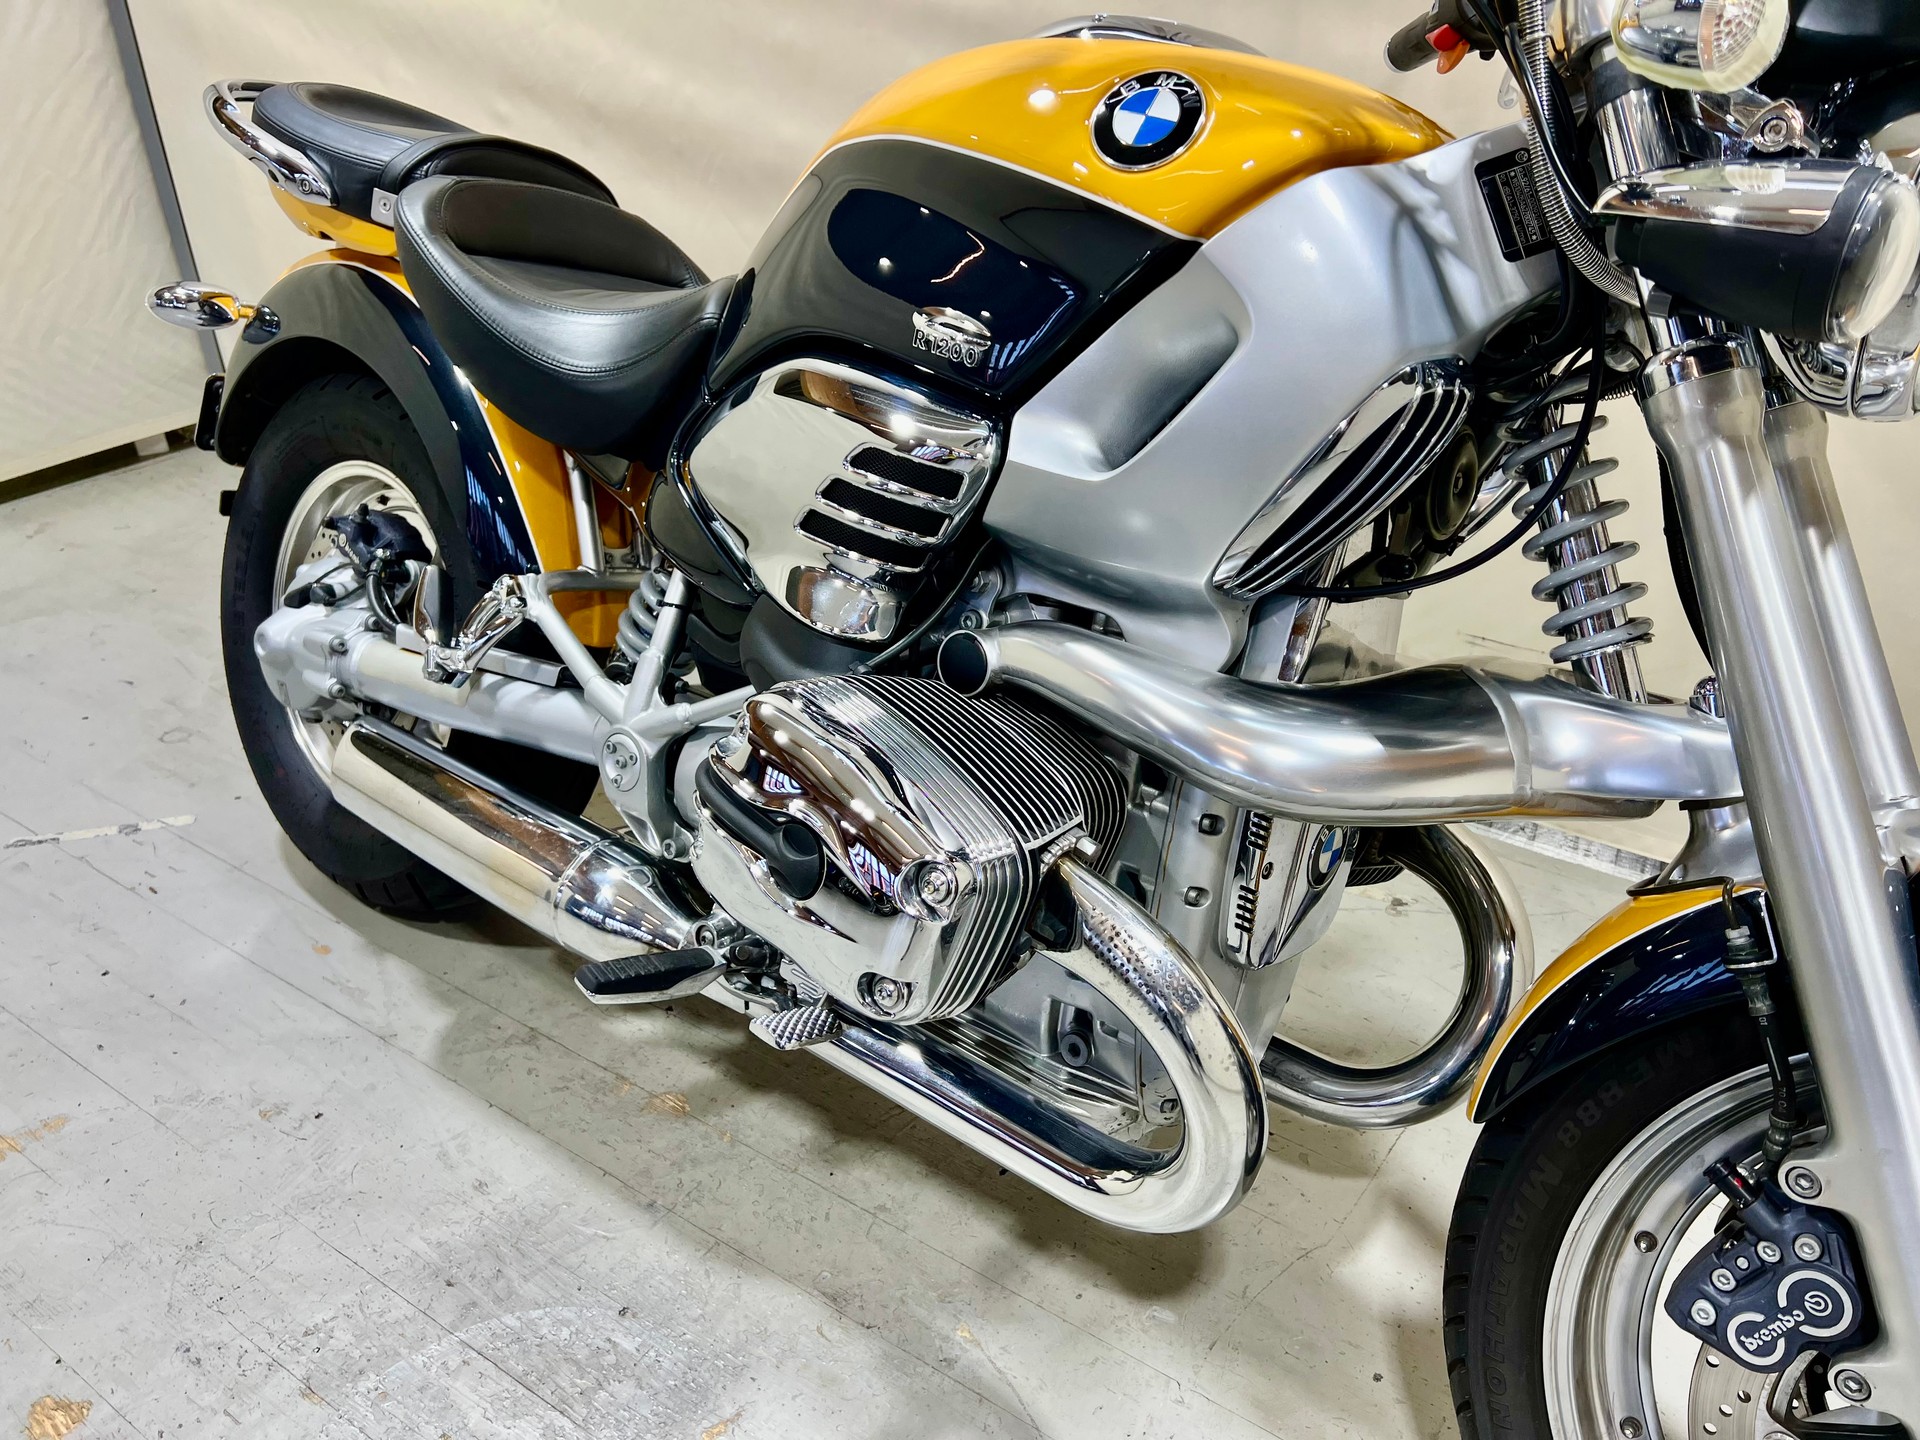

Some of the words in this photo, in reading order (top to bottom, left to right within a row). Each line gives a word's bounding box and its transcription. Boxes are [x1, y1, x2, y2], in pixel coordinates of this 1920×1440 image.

[1120, 73, 1200, 108] BMW
[912, 328, 926, 350] R
[930, 335, 978, 367] 1200
[1486, 1153, 1563, 1430] MARATHON
[1740, 1309, 1805, 1351] brembo
